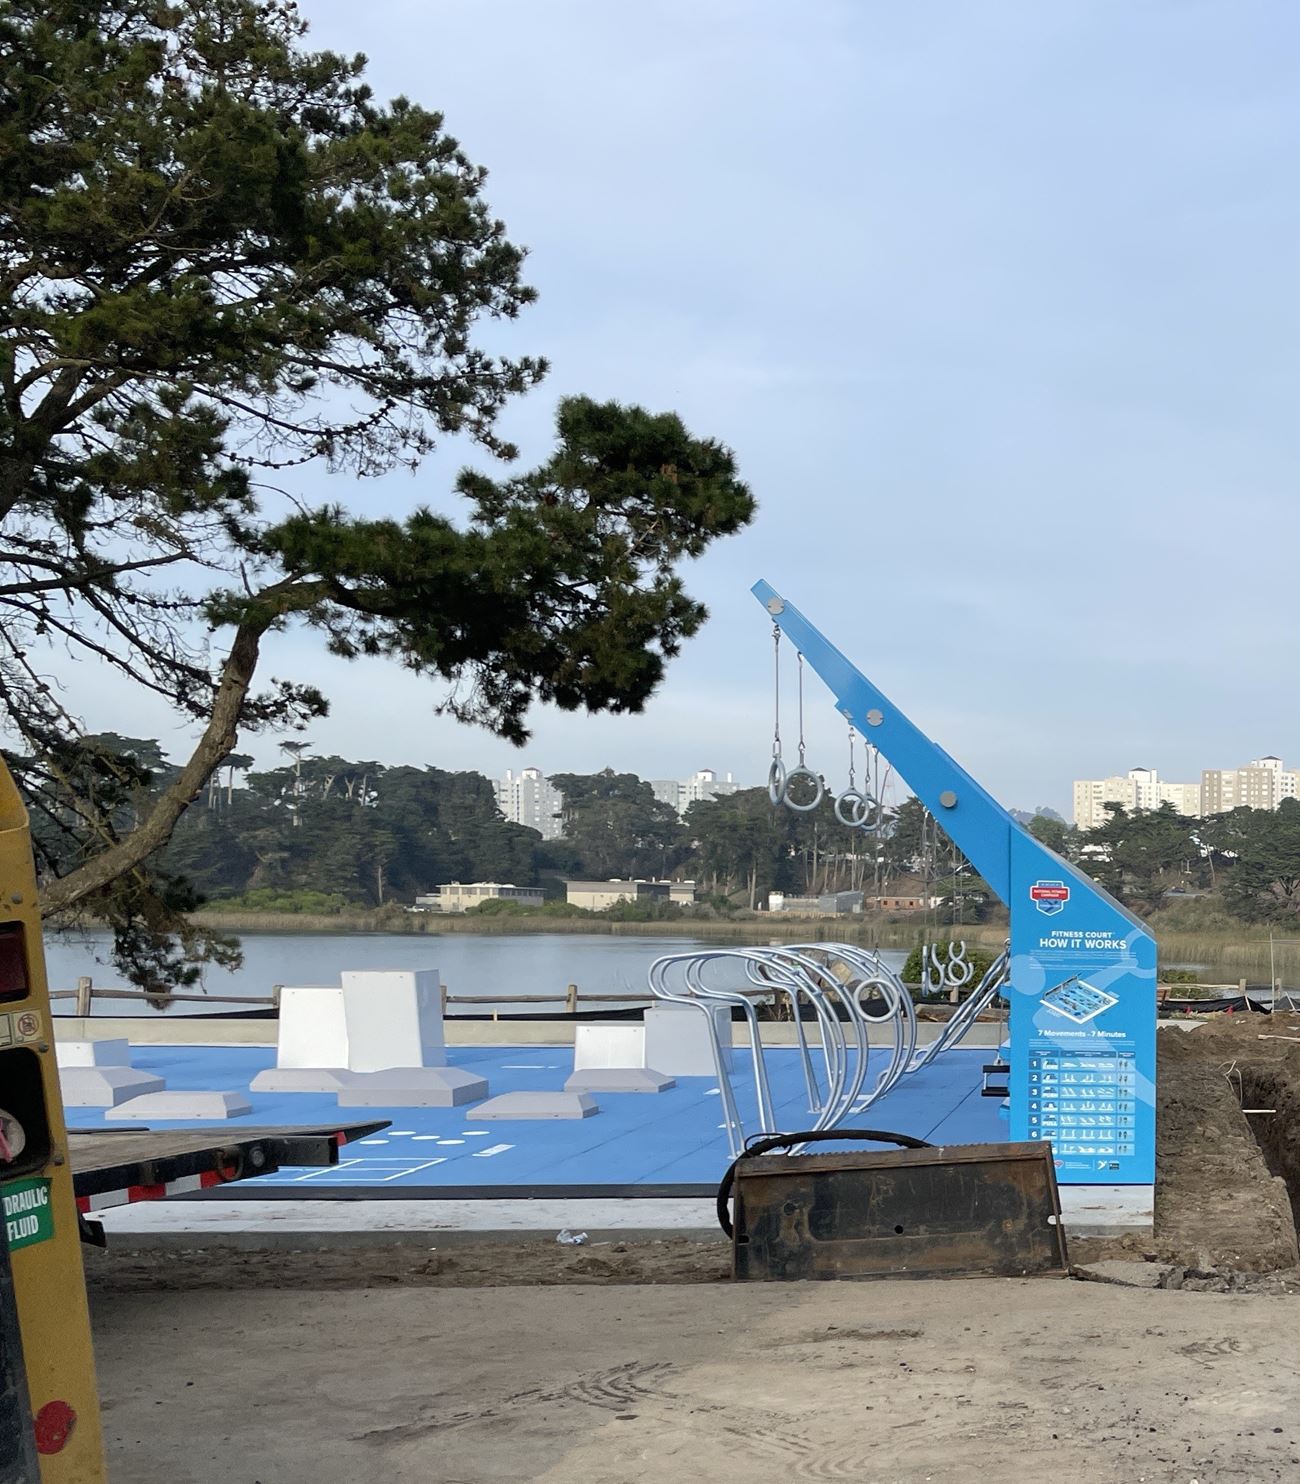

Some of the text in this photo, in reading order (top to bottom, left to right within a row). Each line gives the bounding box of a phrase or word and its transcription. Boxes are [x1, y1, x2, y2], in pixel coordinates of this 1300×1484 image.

[1051, 930, 1113, 939] FITNESS COURT
[1040, 938, 1127, 950] HOW IT WORKS
[1038, 1029, 1043, 1037] 7
[1044, 1029, 1086, 1038] Movements
[1091, 1030, 1096, 1038] 7
[1097, 1030, 1127, 1038] Minutes
[1032, 1088, 1038, 1096] 3
[1031, 1102, 1038, 1110] 4
[1031, 1116, 1038, 1124] 5
[1031, 1130, 1038, 1138] 6
[2, 1186, 48, 1216] DRAULIC
[6, 1214, 39, 1242] FLUID
